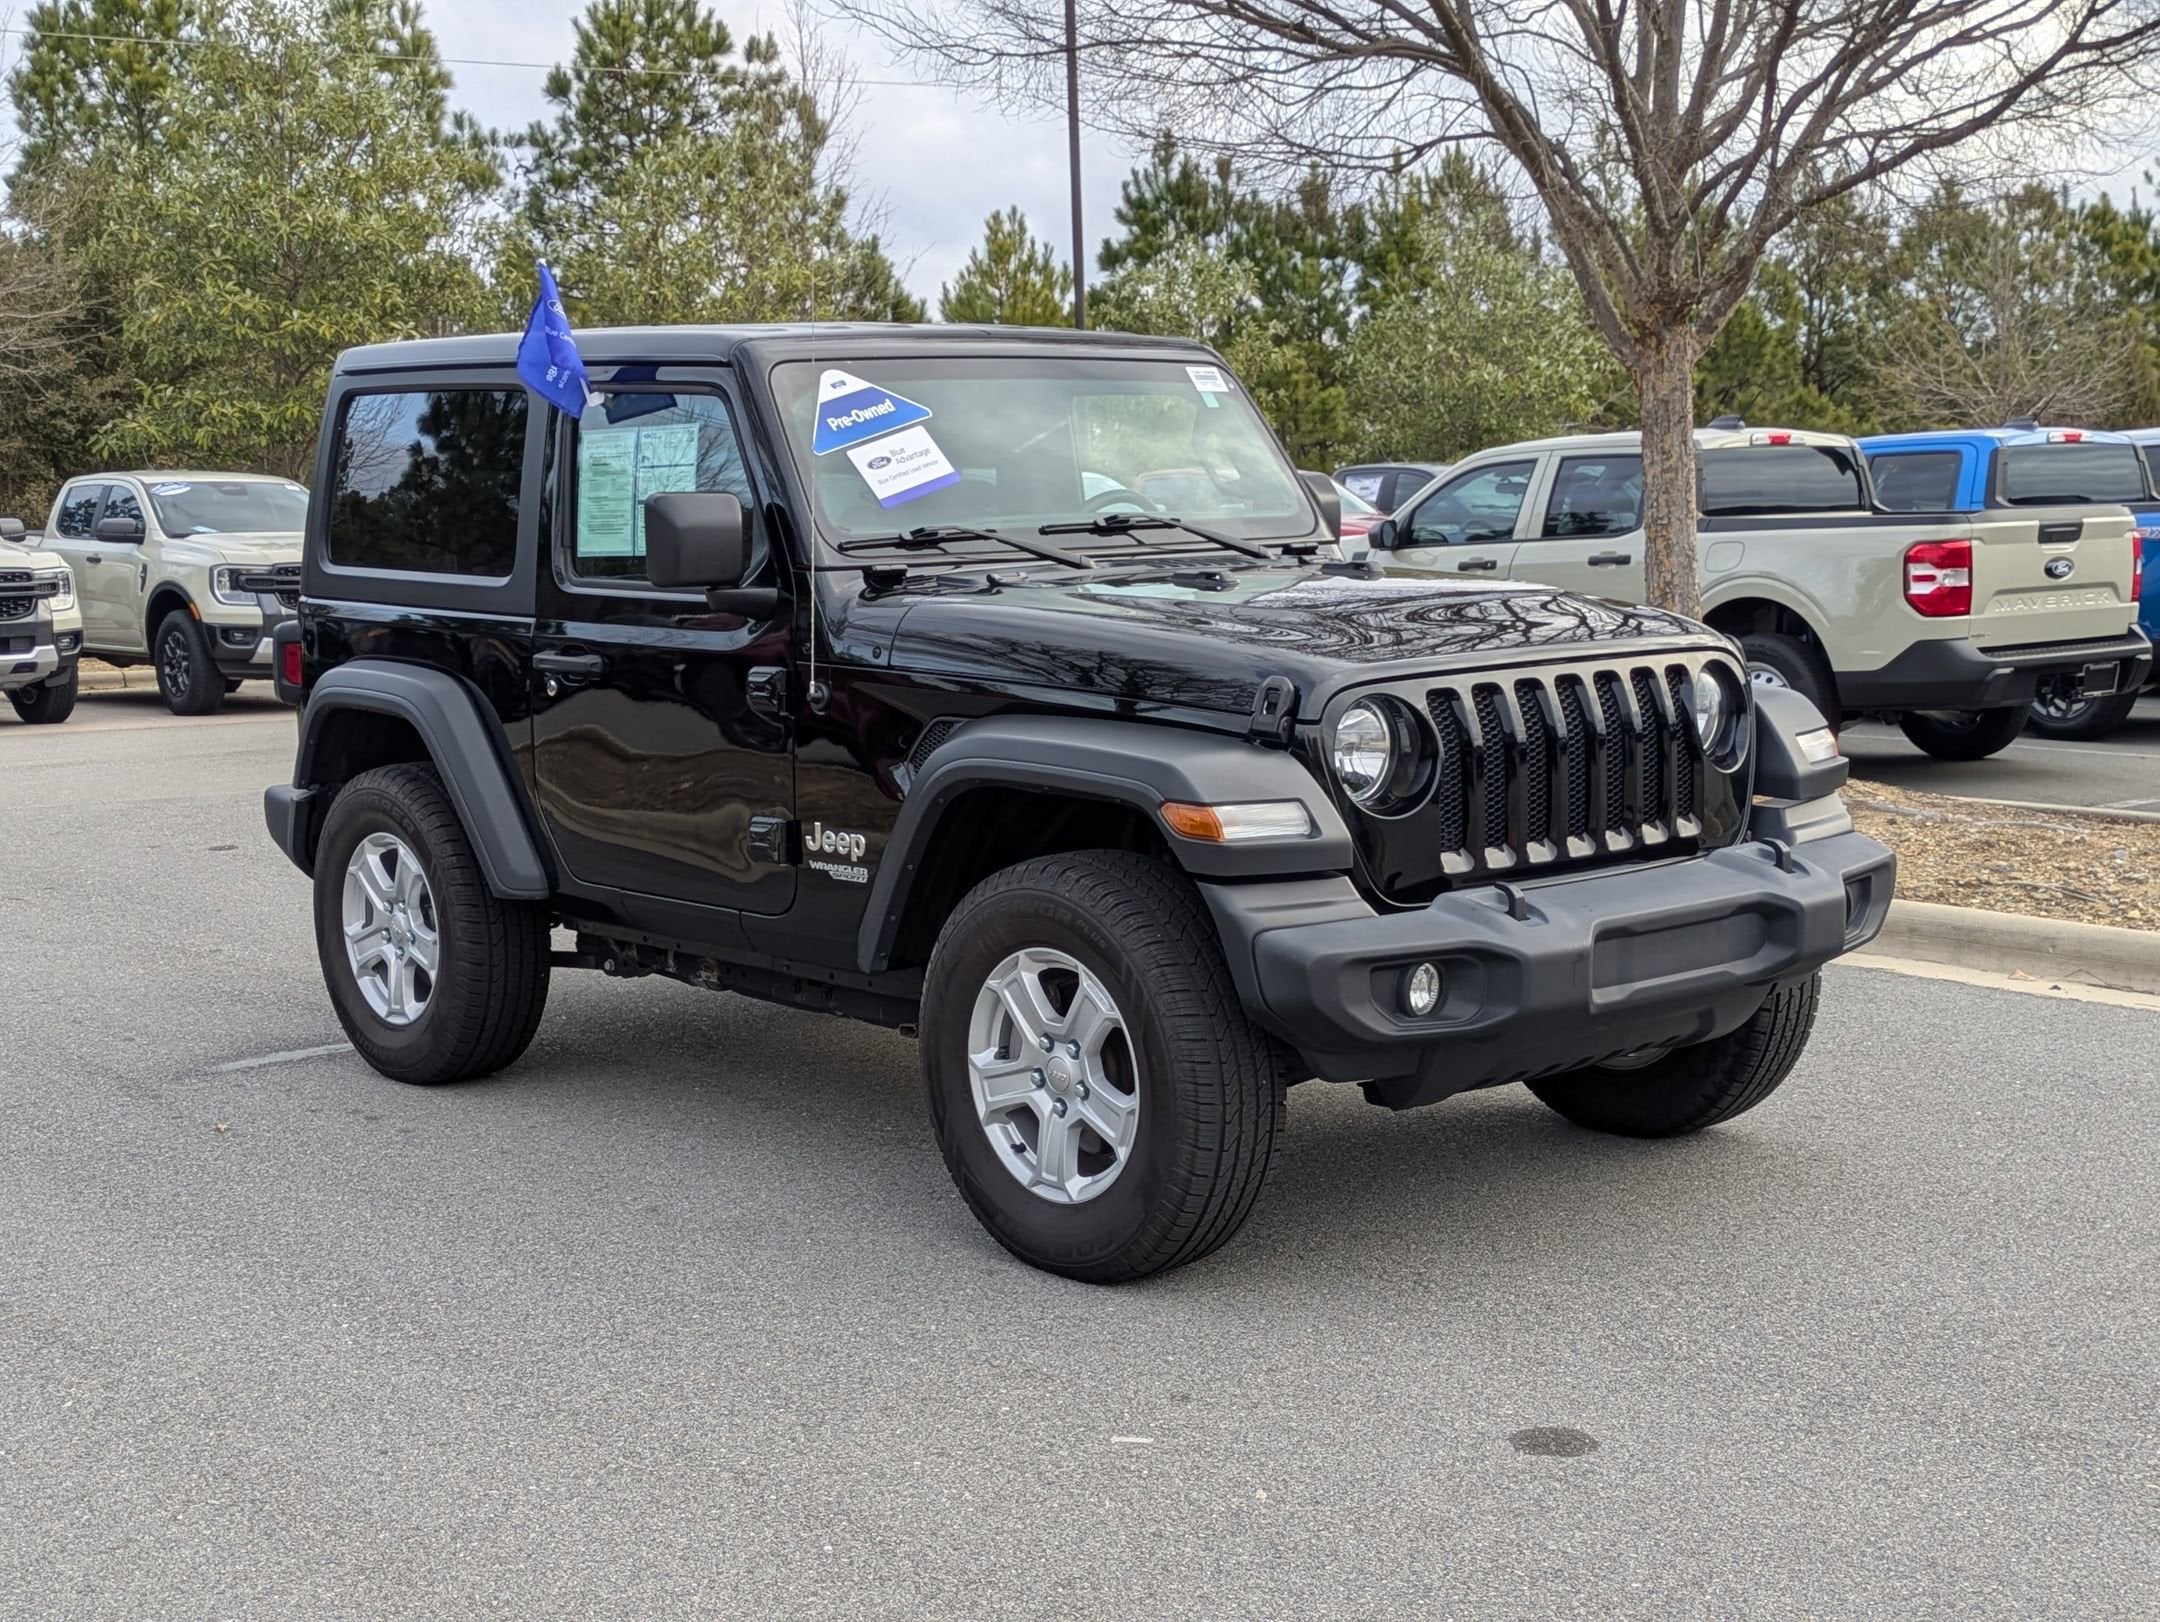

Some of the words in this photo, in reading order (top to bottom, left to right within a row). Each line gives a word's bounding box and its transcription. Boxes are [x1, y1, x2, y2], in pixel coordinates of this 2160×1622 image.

[826, 398, 896, 431] Pre-Owned
[889, 447, 906, 457] Blue
[895, 448, 931, 464] Advantage
[1995, 592, 2109, 612] MAVERICK
[805, 822, 866, 862] Jeep
[809, 860, 868, 876] WRANGLER
